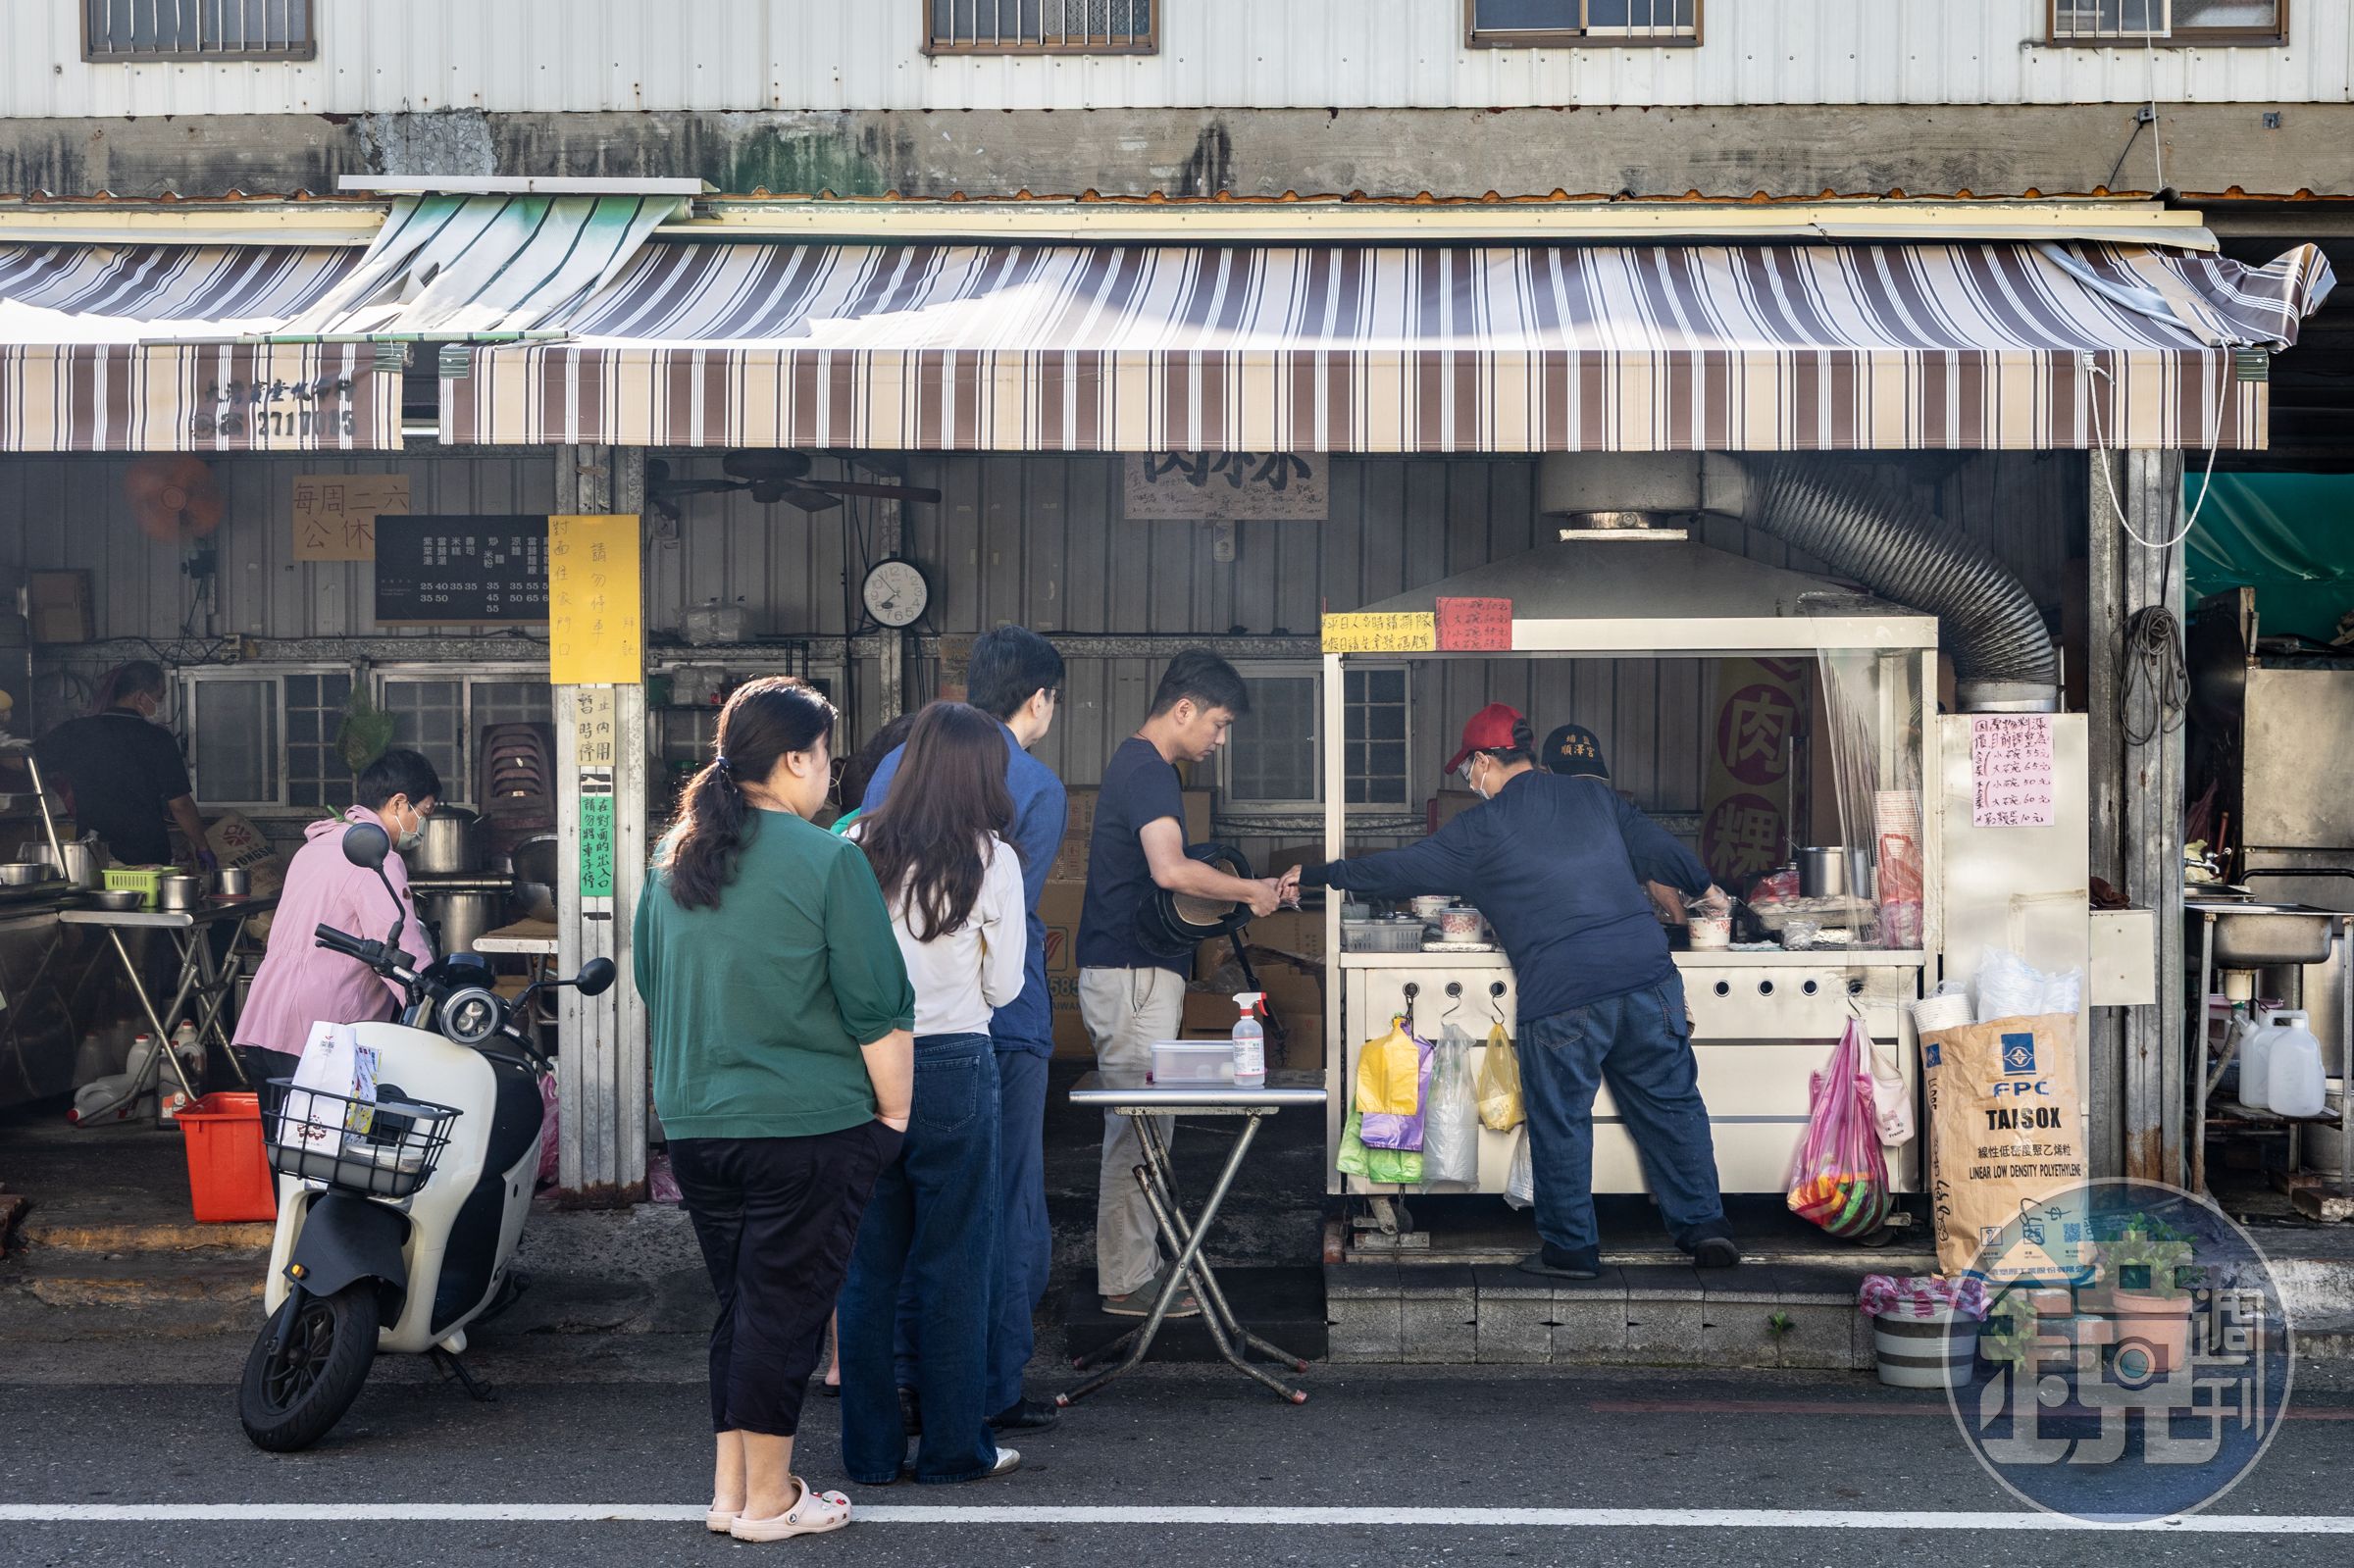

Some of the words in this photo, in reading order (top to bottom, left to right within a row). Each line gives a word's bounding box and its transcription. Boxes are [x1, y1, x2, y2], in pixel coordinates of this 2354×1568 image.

[293, 482, 410, 518] 每周二六
[304, 518, 376, 549] 公休
[465, 536, 476, 556] 壽司
[486, 604, 499, 613] 55
[590, 542, 606, 647] 請勿停車
[578, 692, 594, 762] 暫時停
[582, 797, 595, 888] 請勿將車子停
[596, 798, 611, 888] 在對面的出入口
[1993, 1081, 2050, 1097] FPC
[1985, 1106, 2063, 1131] TAISOX
[1977, 1143, 2072, 1159] 線性低密度聚乙烯粒
[1969, 1166, 1991, 1180] LINEAR
[1993, 1165, 2008, 1179] LOW
[2010, 1164, 2037, 1178] DENSITY
[2039, 1163, 2081, 1177] POLYETHYLENE
